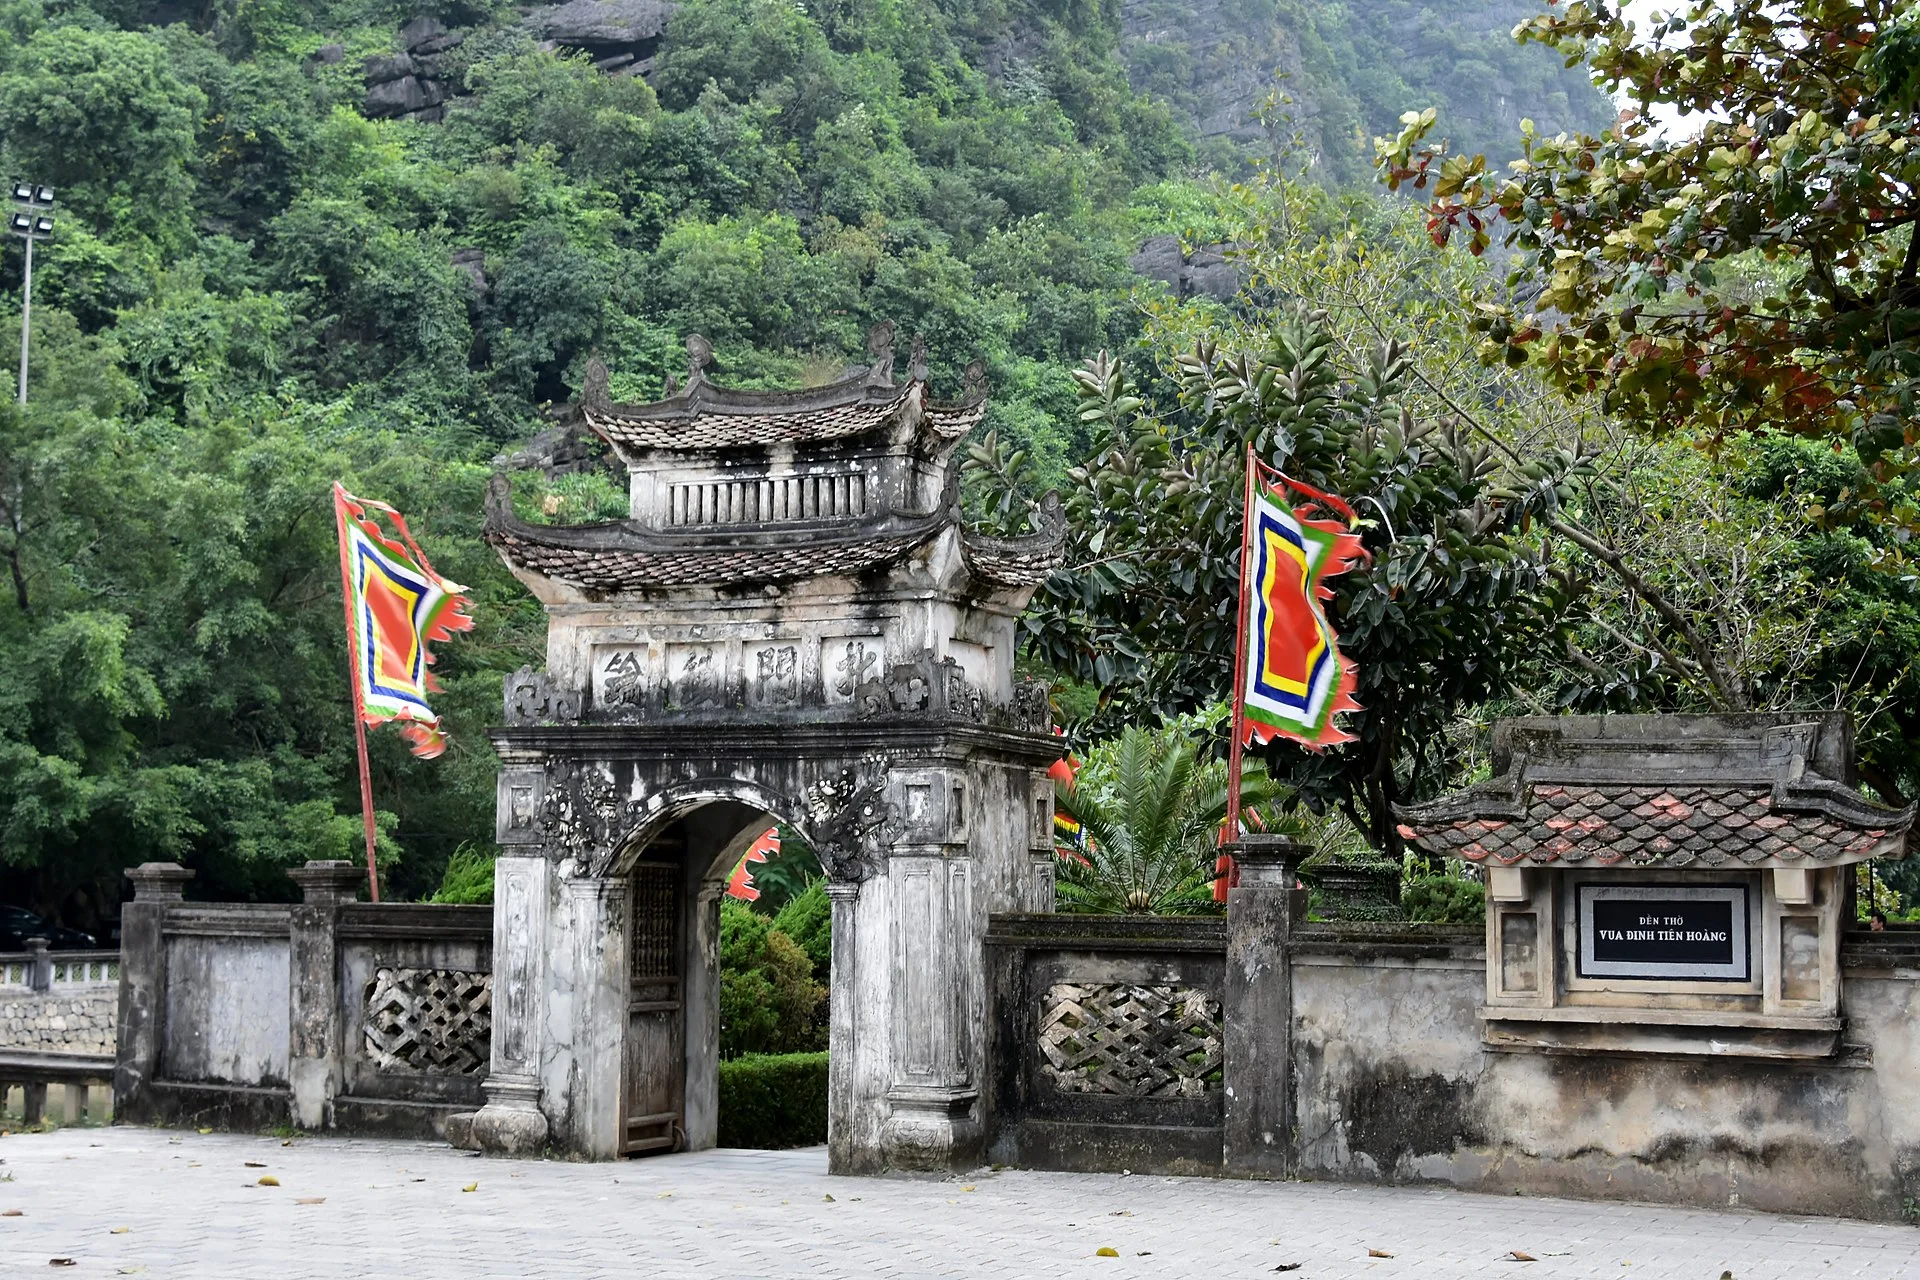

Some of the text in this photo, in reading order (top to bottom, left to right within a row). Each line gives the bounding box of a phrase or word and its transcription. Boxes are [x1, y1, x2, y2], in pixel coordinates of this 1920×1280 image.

[1600, 928, 1727, 942] VUA ĐINH TIÊN HOÀNG
